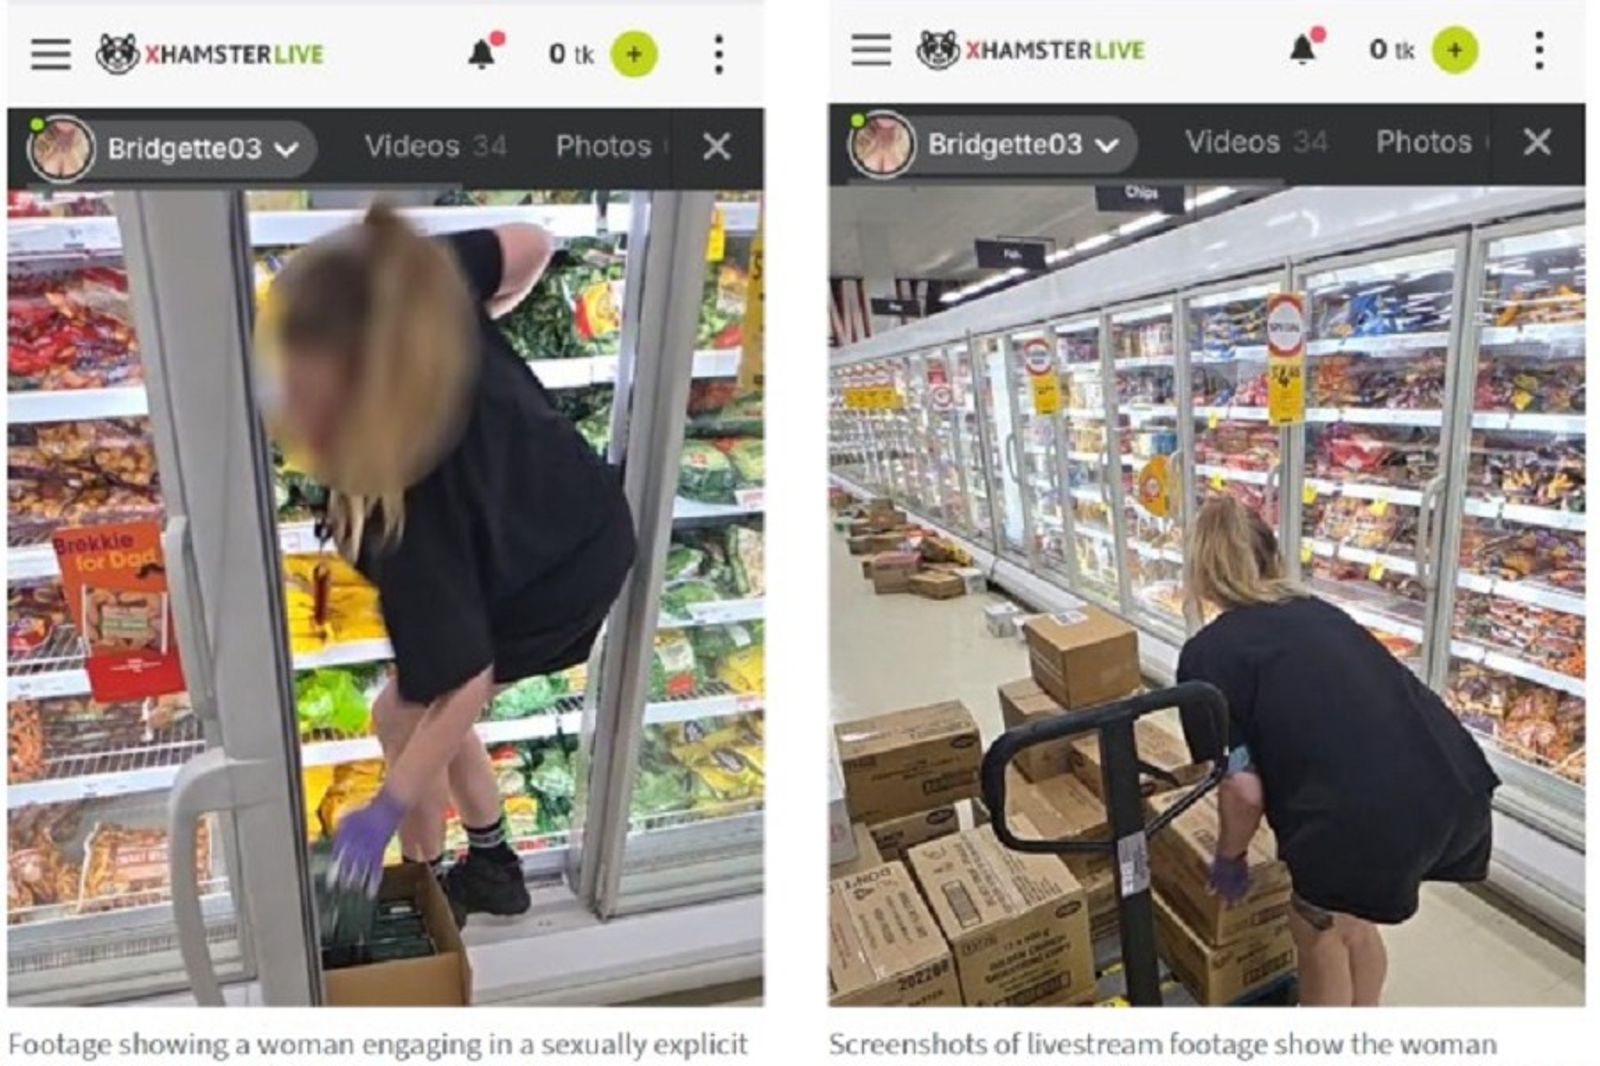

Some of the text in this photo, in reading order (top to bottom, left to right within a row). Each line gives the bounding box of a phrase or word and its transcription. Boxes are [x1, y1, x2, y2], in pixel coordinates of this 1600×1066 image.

[548, 43, 595, 64] 0 tk
[1369, 38, 1415, 60] 0 tk
[108, 137, 263, 166] Bridgette03
[364, 133, 508, 158] Videos 34
[556, 134, 652, 158] Photos
[929, 132, 1084, 161] Bridgette03
[1185, 128, 1330, 154] Videos 34
[1377, 129, 1473, 153] Photos
[1125, 185, 1159, 200] Chips
[53, 531, 134, 556] Brekkie
[76, 548, 158, 572] for Dad
